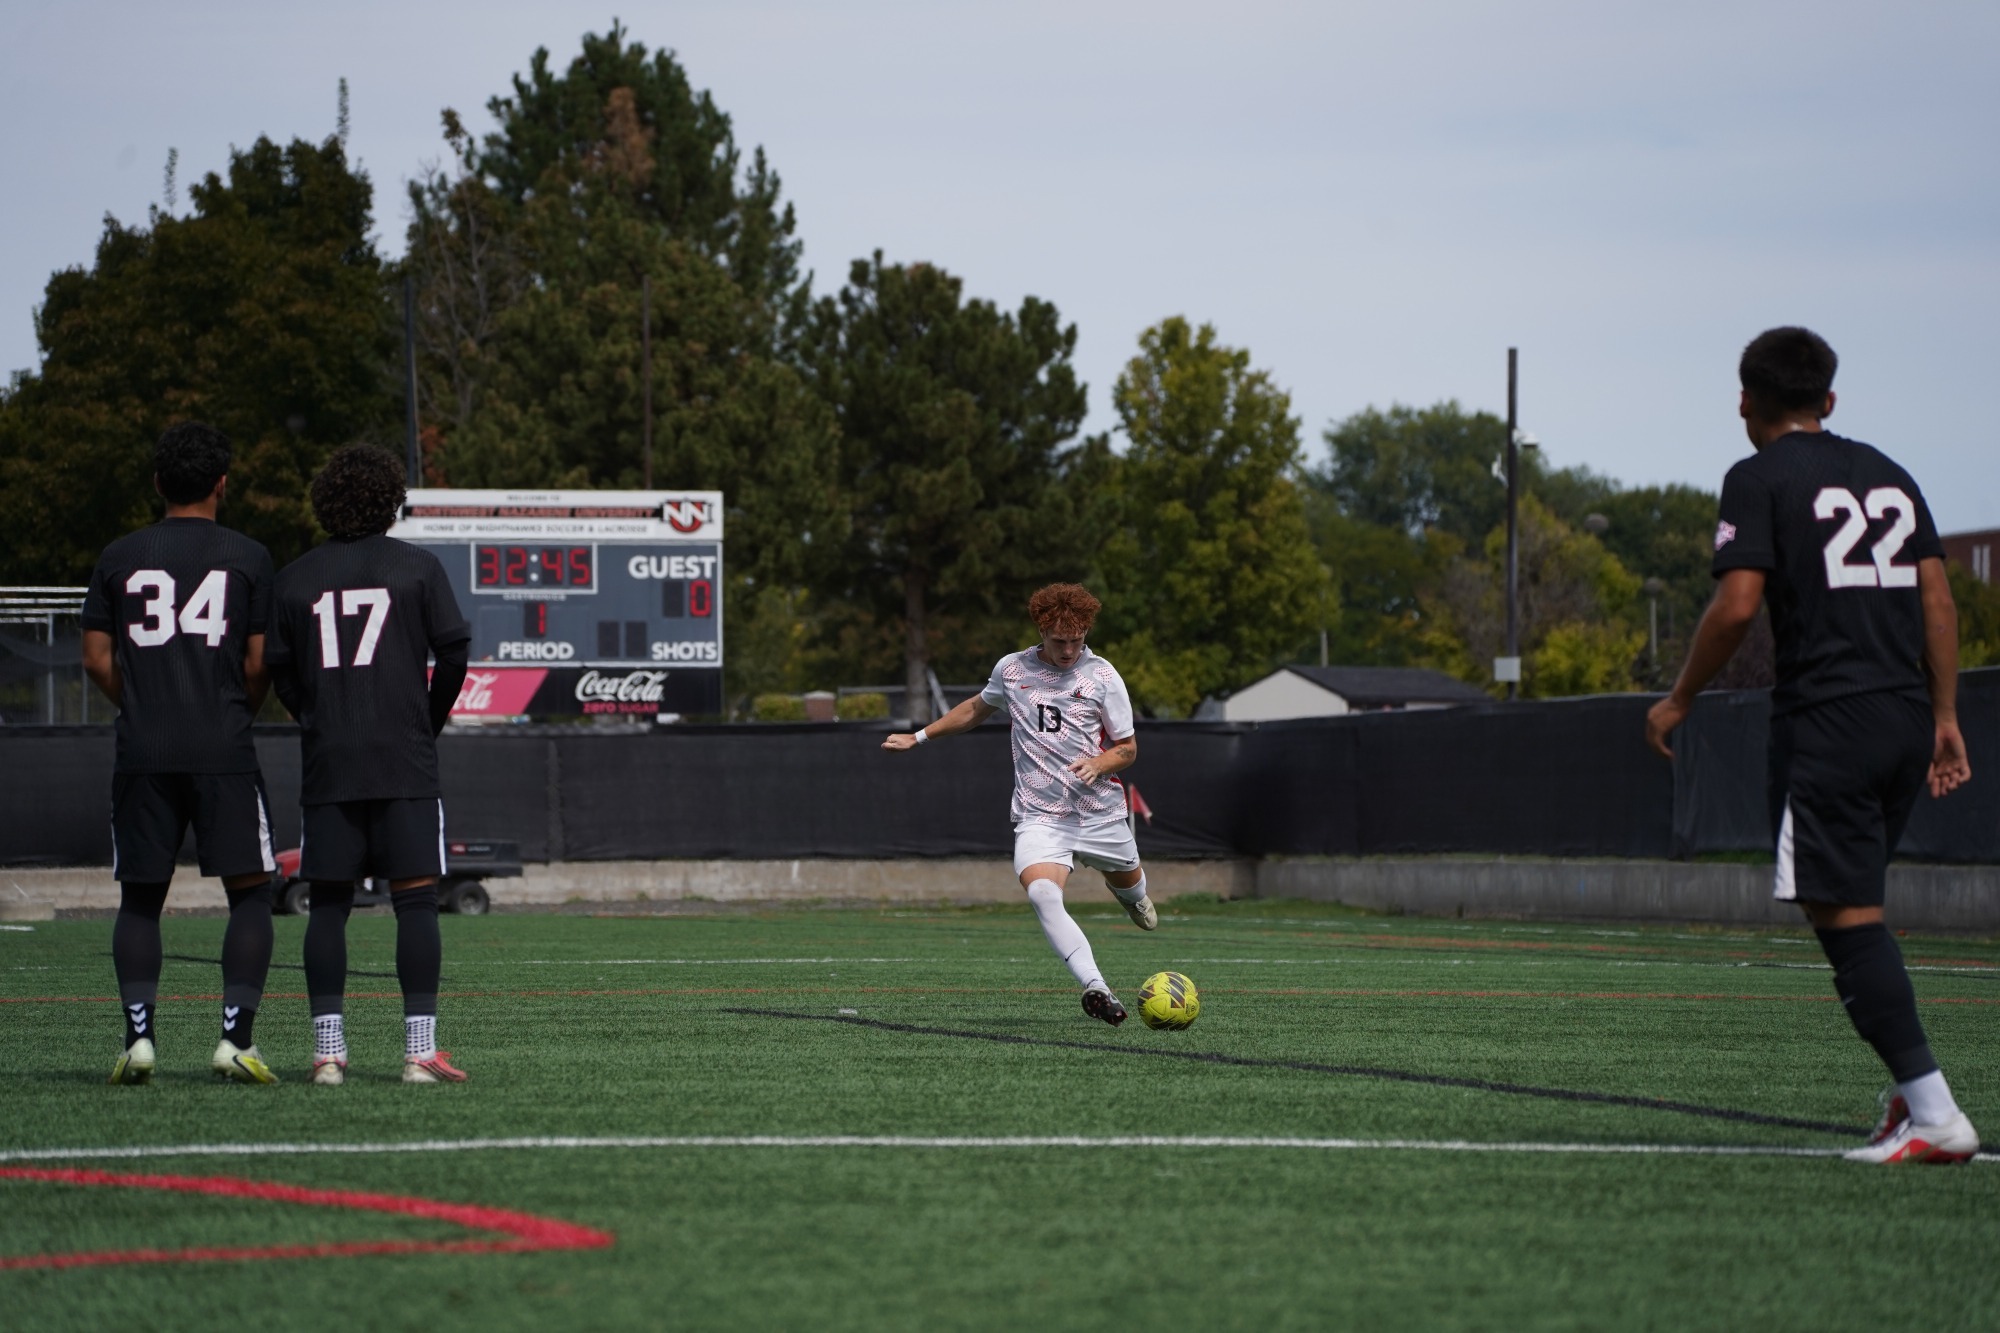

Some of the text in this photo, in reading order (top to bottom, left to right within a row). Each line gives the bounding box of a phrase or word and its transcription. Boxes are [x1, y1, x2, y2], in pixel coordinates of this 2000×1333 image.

[423, 524, 454, 532] HOME
[459, 524, 471, 532] OF
[1813, 487, 1917, 588] 22
[481, 548, 590, 584] 32:45
[628, 555, 716, 579] GUEST
[126, 570, 227, 647] 34
[690, 580, 711, 616] 0
[312, 588, 391, 668] 17
[538, 603, 546, 634] 1
[498, 641, 574, 660] PERIOD
[652, 641, 717, 660] SHOTS
[1037, 704, 1061, 732] 13
